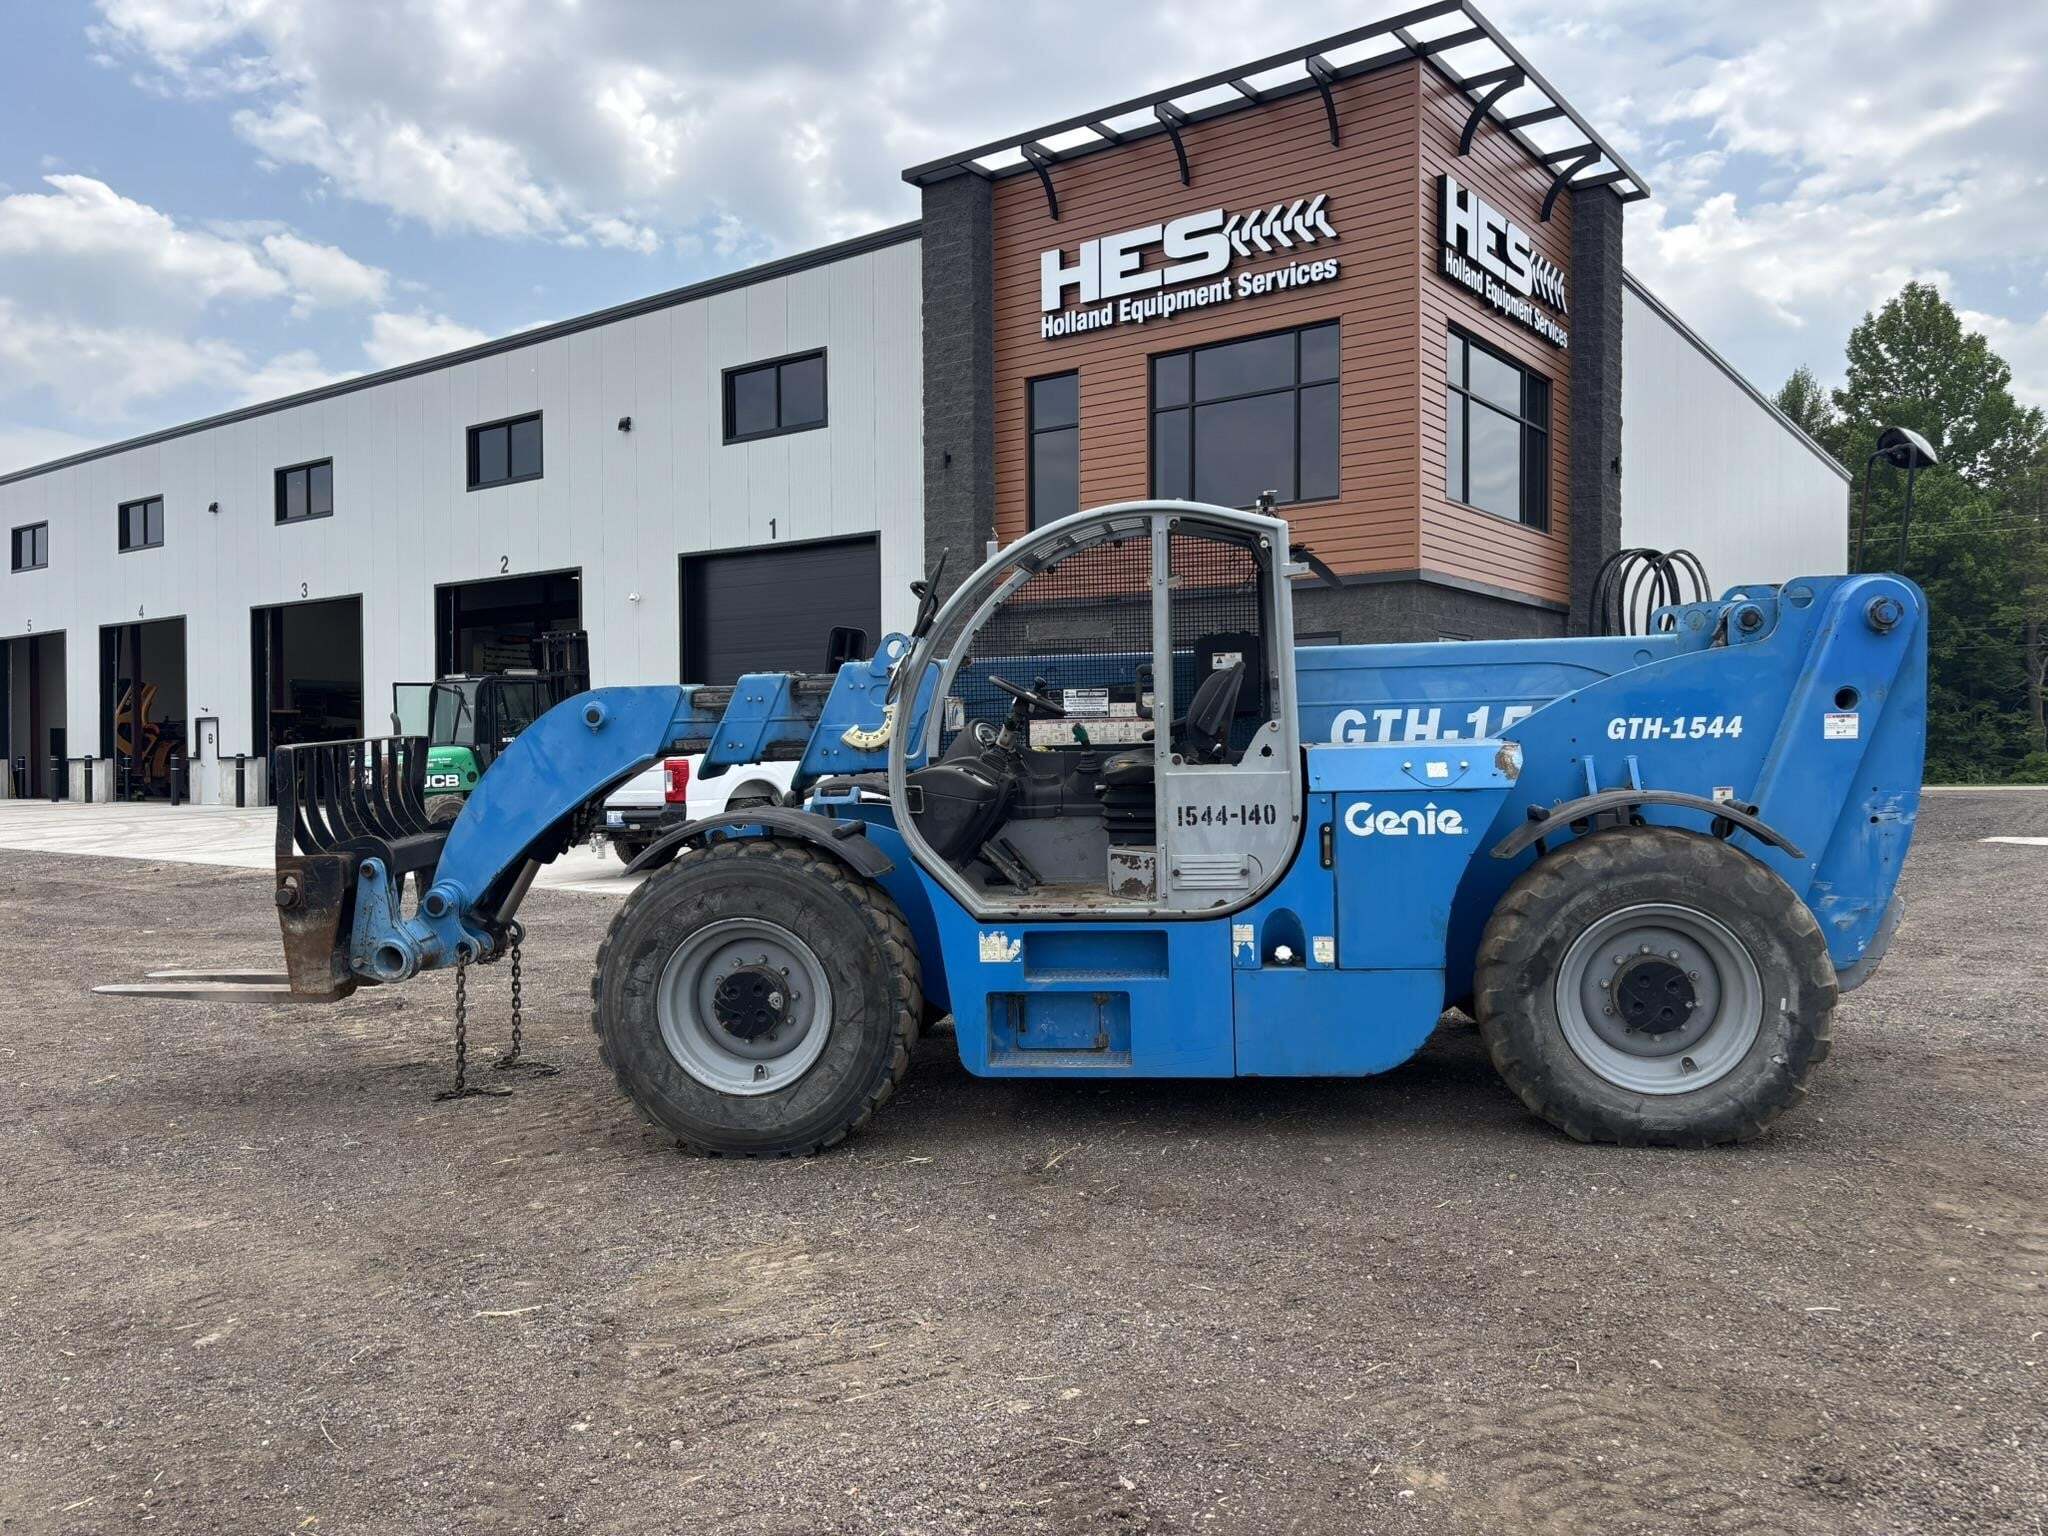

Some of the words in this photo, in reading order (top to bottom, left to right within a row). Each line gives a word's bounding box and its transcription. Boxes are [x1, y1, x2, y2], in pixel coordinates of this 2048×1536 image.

[1446, 174, 1532, 297] HES
[1041, 208, 1231, 312] HES
[1041, 303, 1112, 338] Holland
[1119, 276, 1231, 324] Equipment
[1238, 259, 1338, 296] Services
[1445, 248, 1484, 293] Holland
[1485, 276, 1533, 326] Equipment
[1534, 308, 1568, 348] Services
[769, 518, 776, 539] 1
[500, 555, 508, 574] 2
[301, 582, 308, 598] 3
[139, 604, 144, 618] 4
[27, 619, 32, 632] 5
[1607, 715, 1743, 740] GTH-1544
[424, 775, 459, 788] JCB
[1178, 804, 1276, 826] 1544-140
